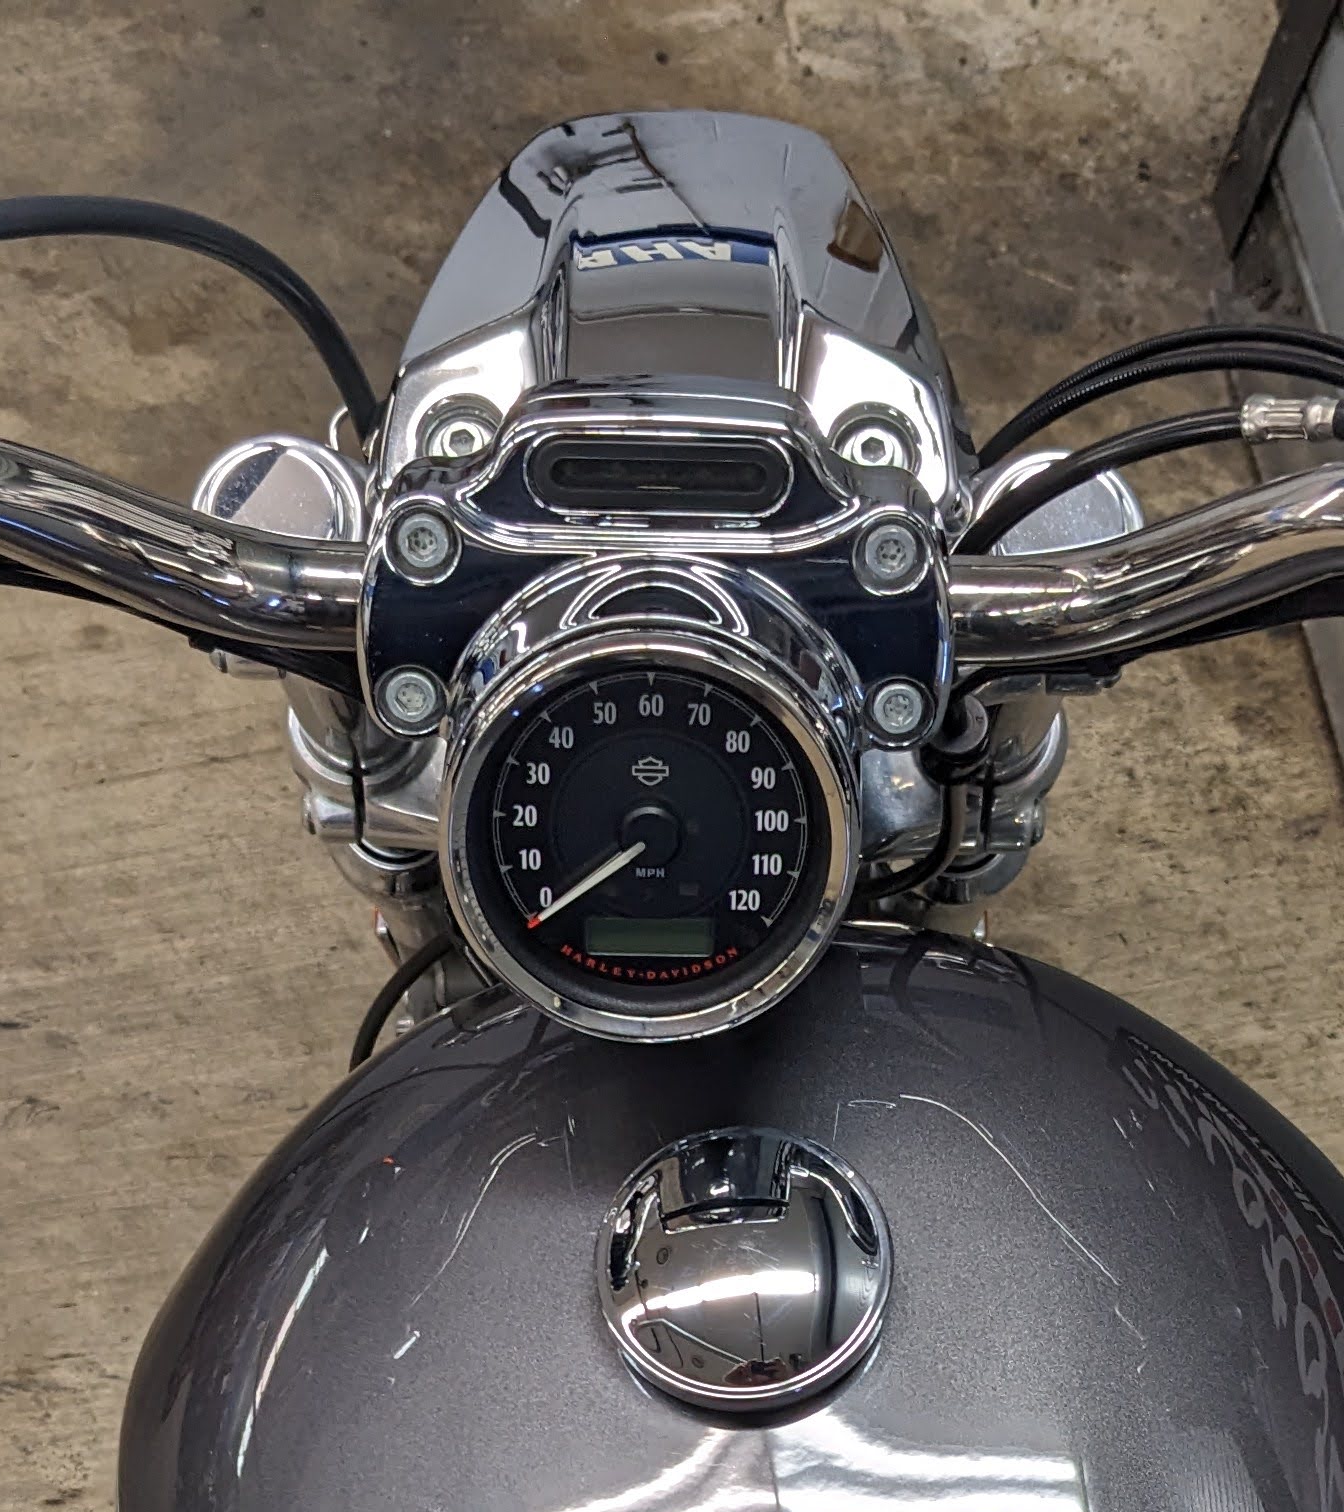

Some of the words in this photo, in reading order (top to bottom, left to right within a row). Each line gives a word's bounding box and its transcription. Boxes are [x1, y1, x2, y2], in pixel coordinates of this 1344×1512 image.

[593, 702, 618, 725] 50
[639, 694, 665, 717] 60
[688, 703, 712, 726] 70
[549, 726, 574, 749] 40
[725, 731, 751, 753] 80
[526, 763, 551, 785] 30
[751, 766, 776, 789] 90
[512, 805, 538, 827] 20
[755, 809, 789, 832] 100
[518, 849, 542, 871] 10
[752, 854, 783, 876] 110
[635, 867, 666, 878] MPH
[539, 887, 553, 907] 0
[729, 890, 761, 912] 120
[561, 943, 739, 980] HARLEY-DAVIDSON
